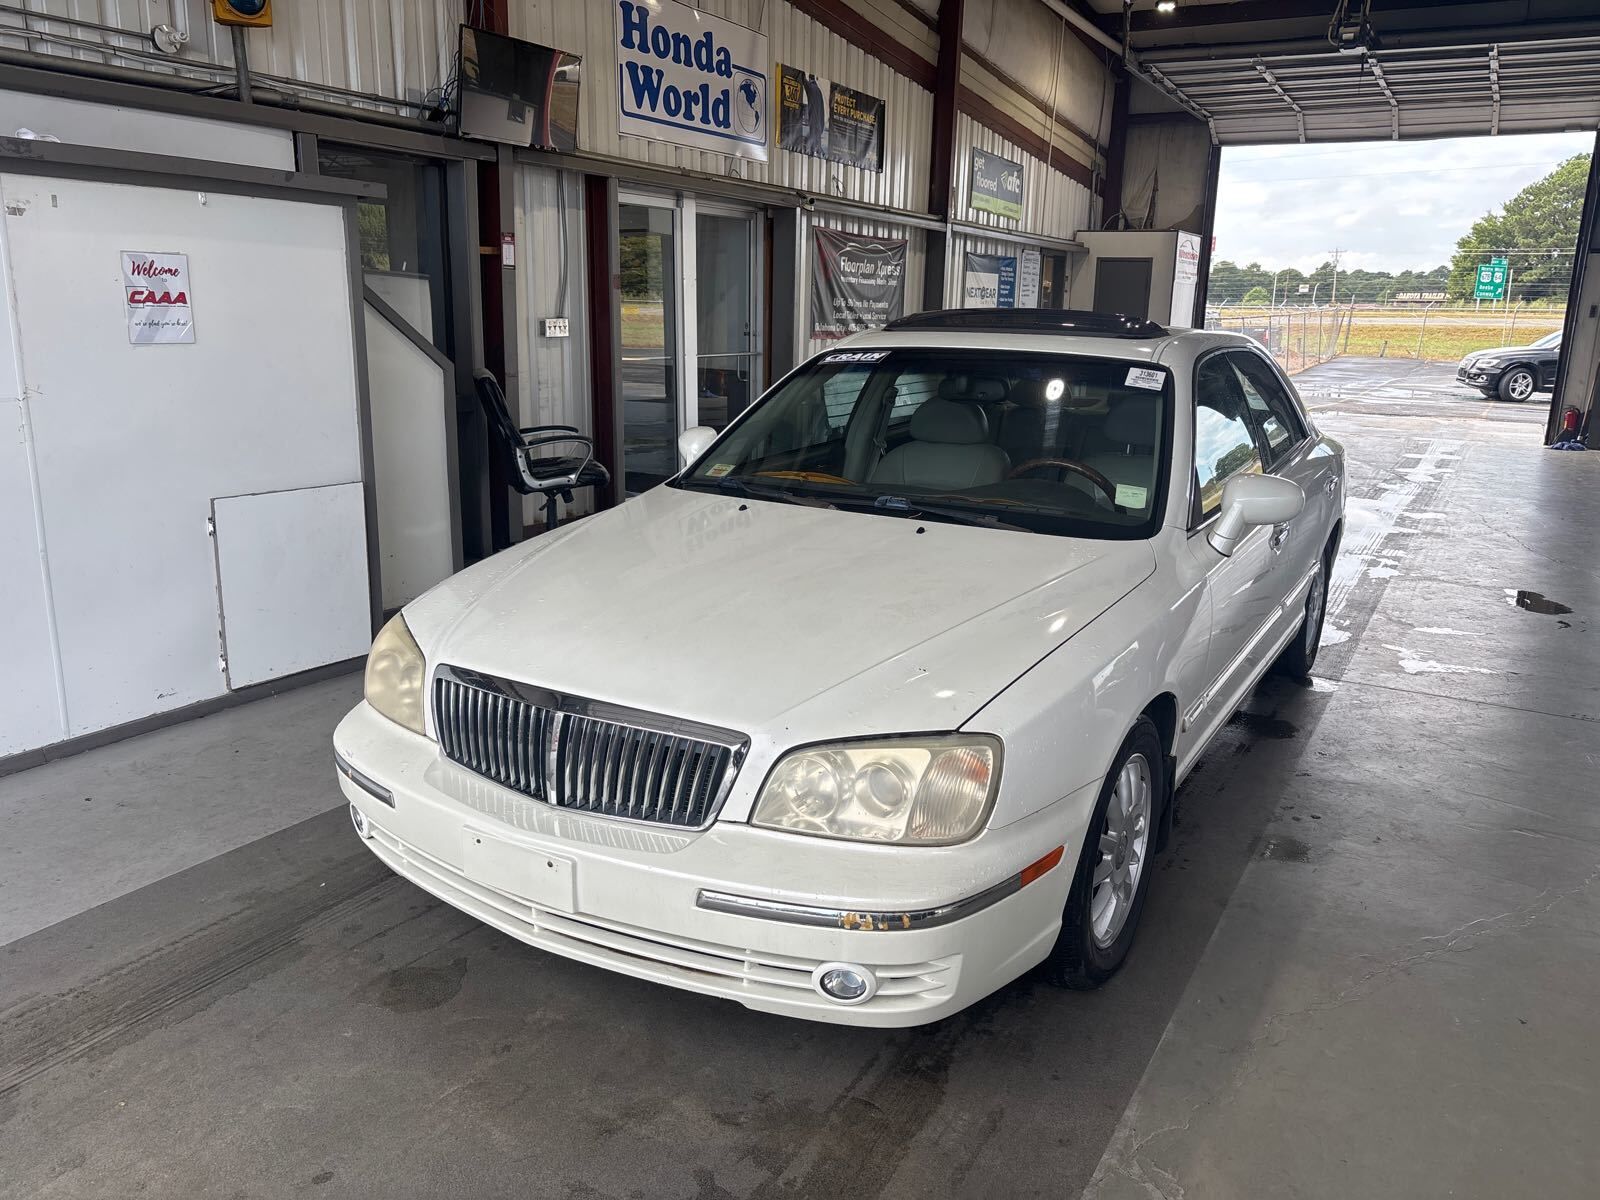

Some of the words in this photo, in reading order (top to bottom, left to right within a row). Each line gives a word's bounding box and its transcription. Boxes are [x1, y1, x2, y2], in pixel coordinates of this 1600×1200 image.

[619, 0, 733, 79] Honda
[626, 61, 731, 129] World
[833, 103, 850, 116] EVERY
[850, 109, 876, 125] PURCHASE
[974, 157, 985, 171] get
[976, 171, 998, 191] floored
[1007, 171, 1020, 193] afc
[131, 259, 181, 278] Welcome
[840, 256, 875, 276] Floorplan
[876, 260, 901, 277] Xpress
[129, 291, 187, 304] CAAA
[824, 352, 886, 362] CRAIN
